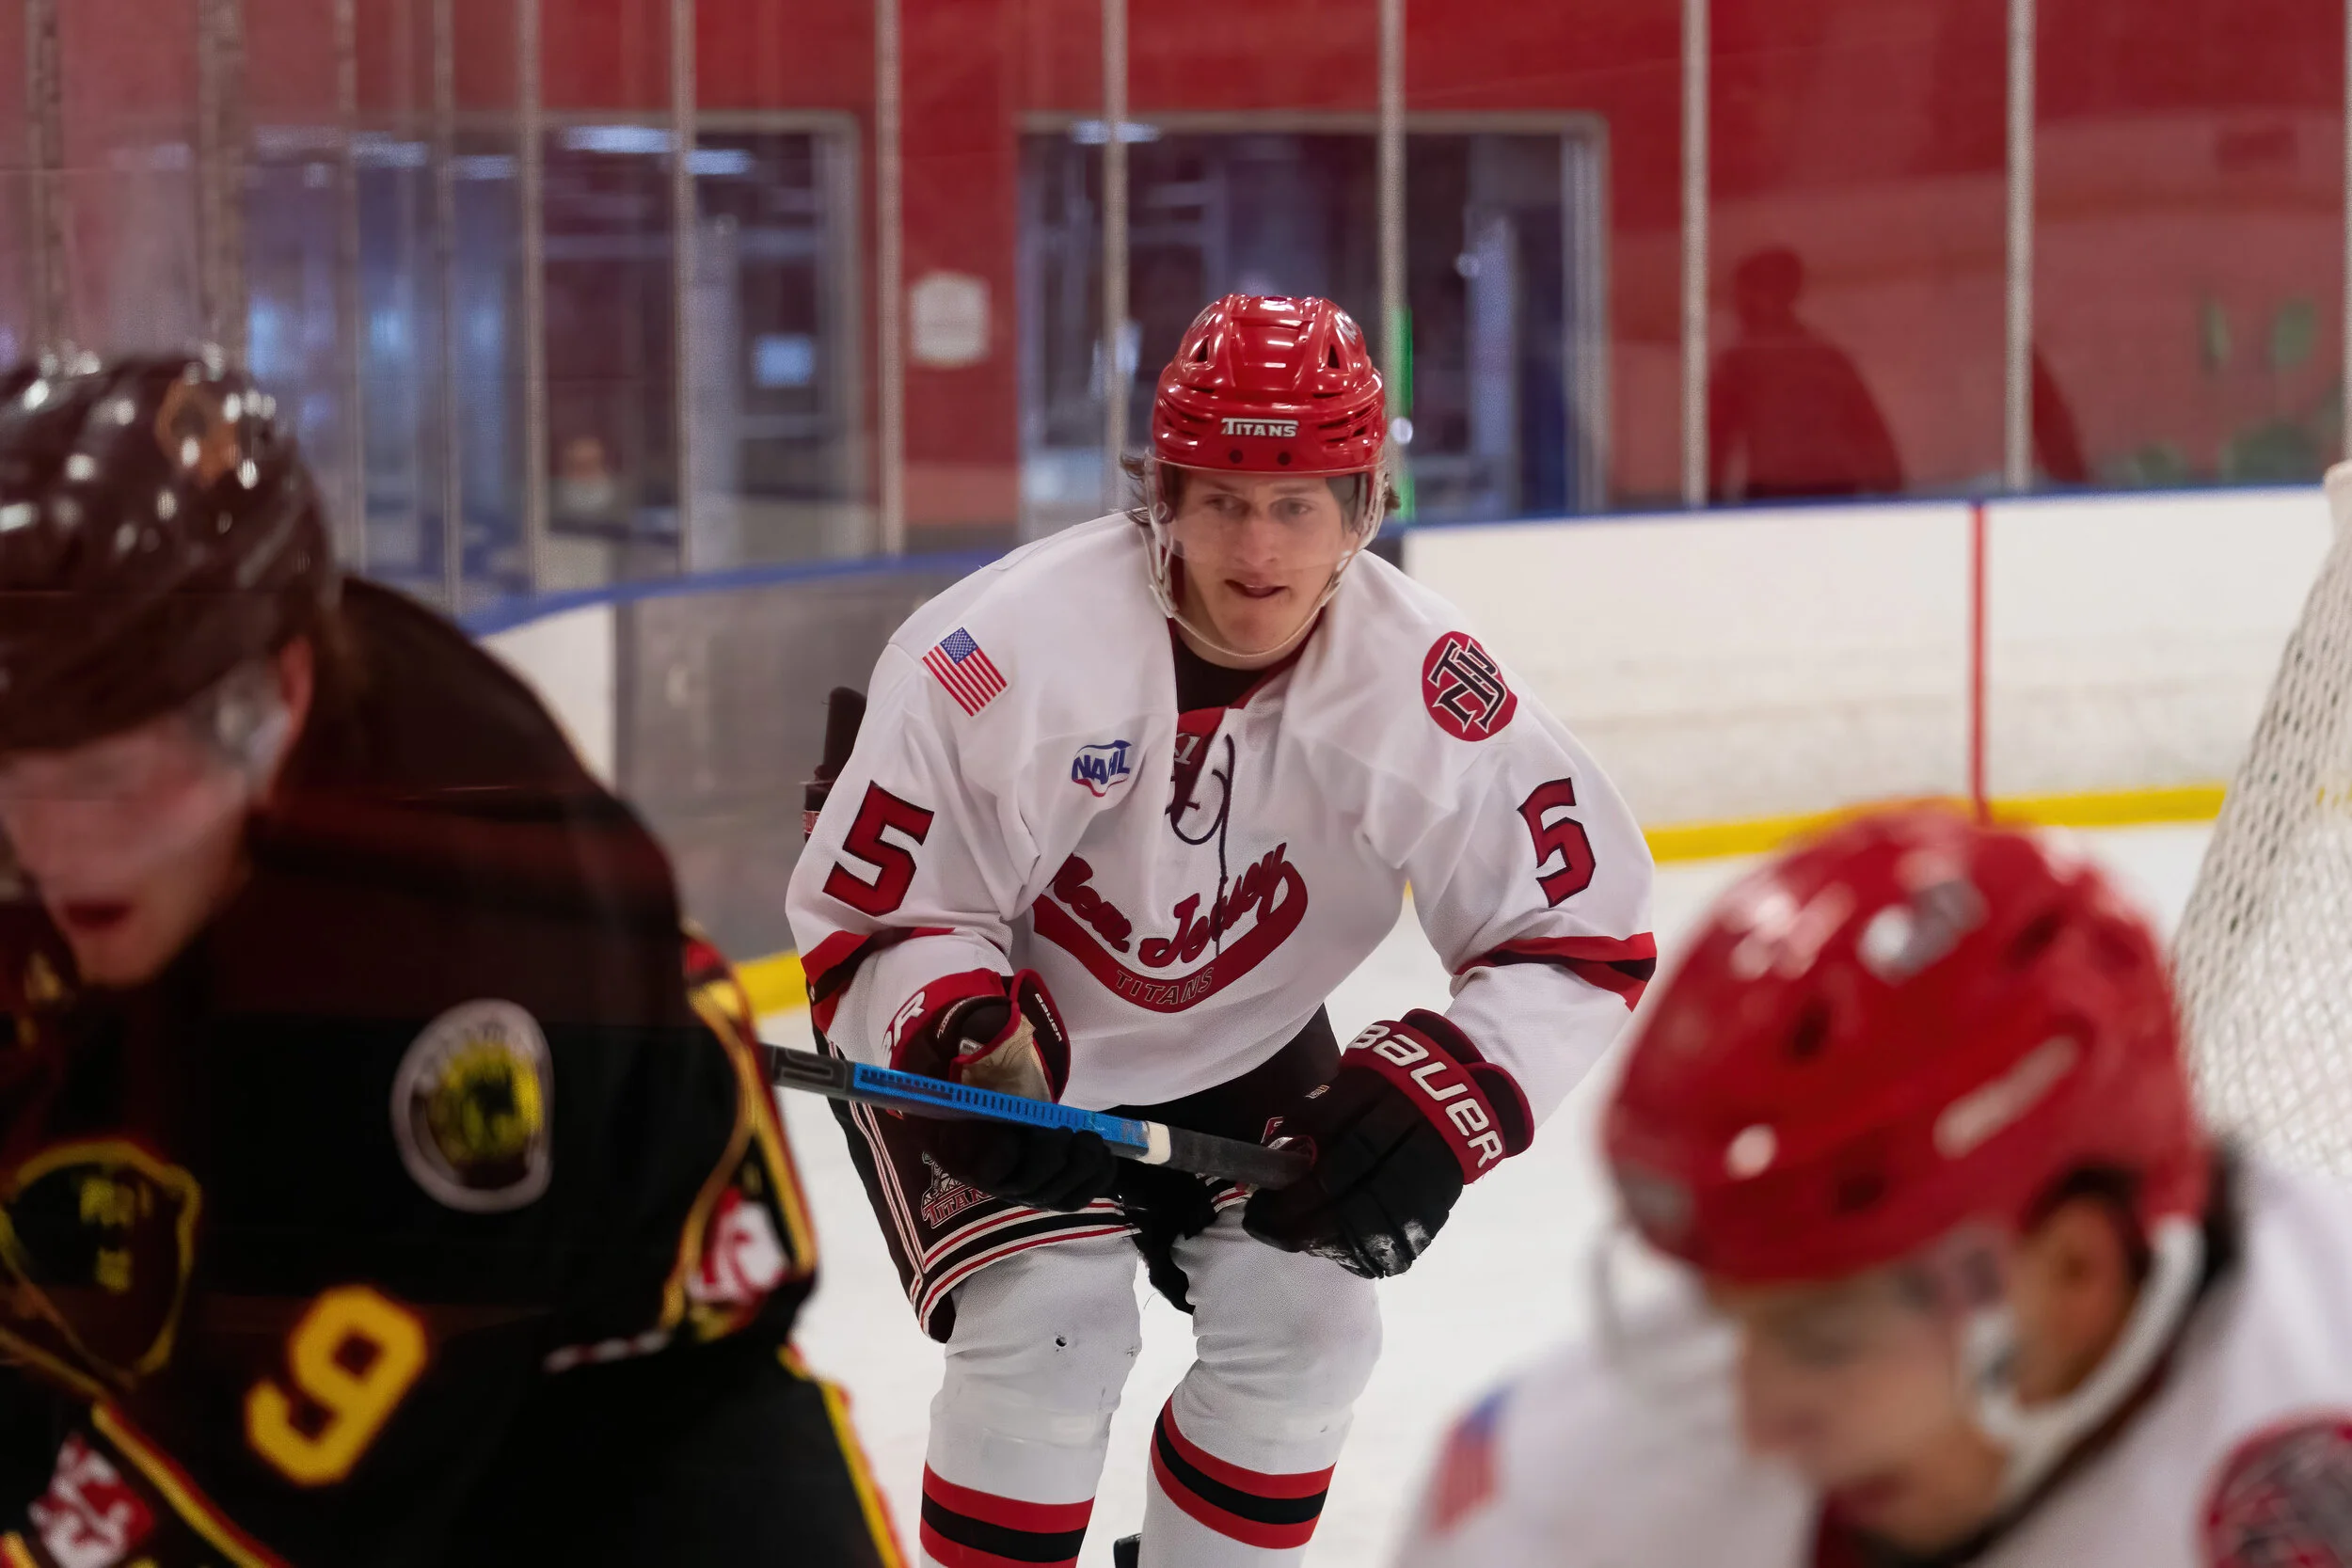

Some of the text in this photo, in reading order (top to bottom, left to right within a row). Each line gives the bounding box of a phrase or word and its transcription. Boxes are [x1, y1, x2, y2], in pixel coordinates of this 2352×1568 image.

[1221, 418, 1299, 437] TITANS
[1072, 741, 1131, 785] NAHL
[821, 780, 935, 917] 5
[1517, 777, 1596, 908] 5
[1116, 966, 1215, 1005] TITANS
[1345, 1024, 1503, 1169] BAUER
[922, 1184, 993, 1227] TITAN
[243, 1283, 429, 1486] 9
